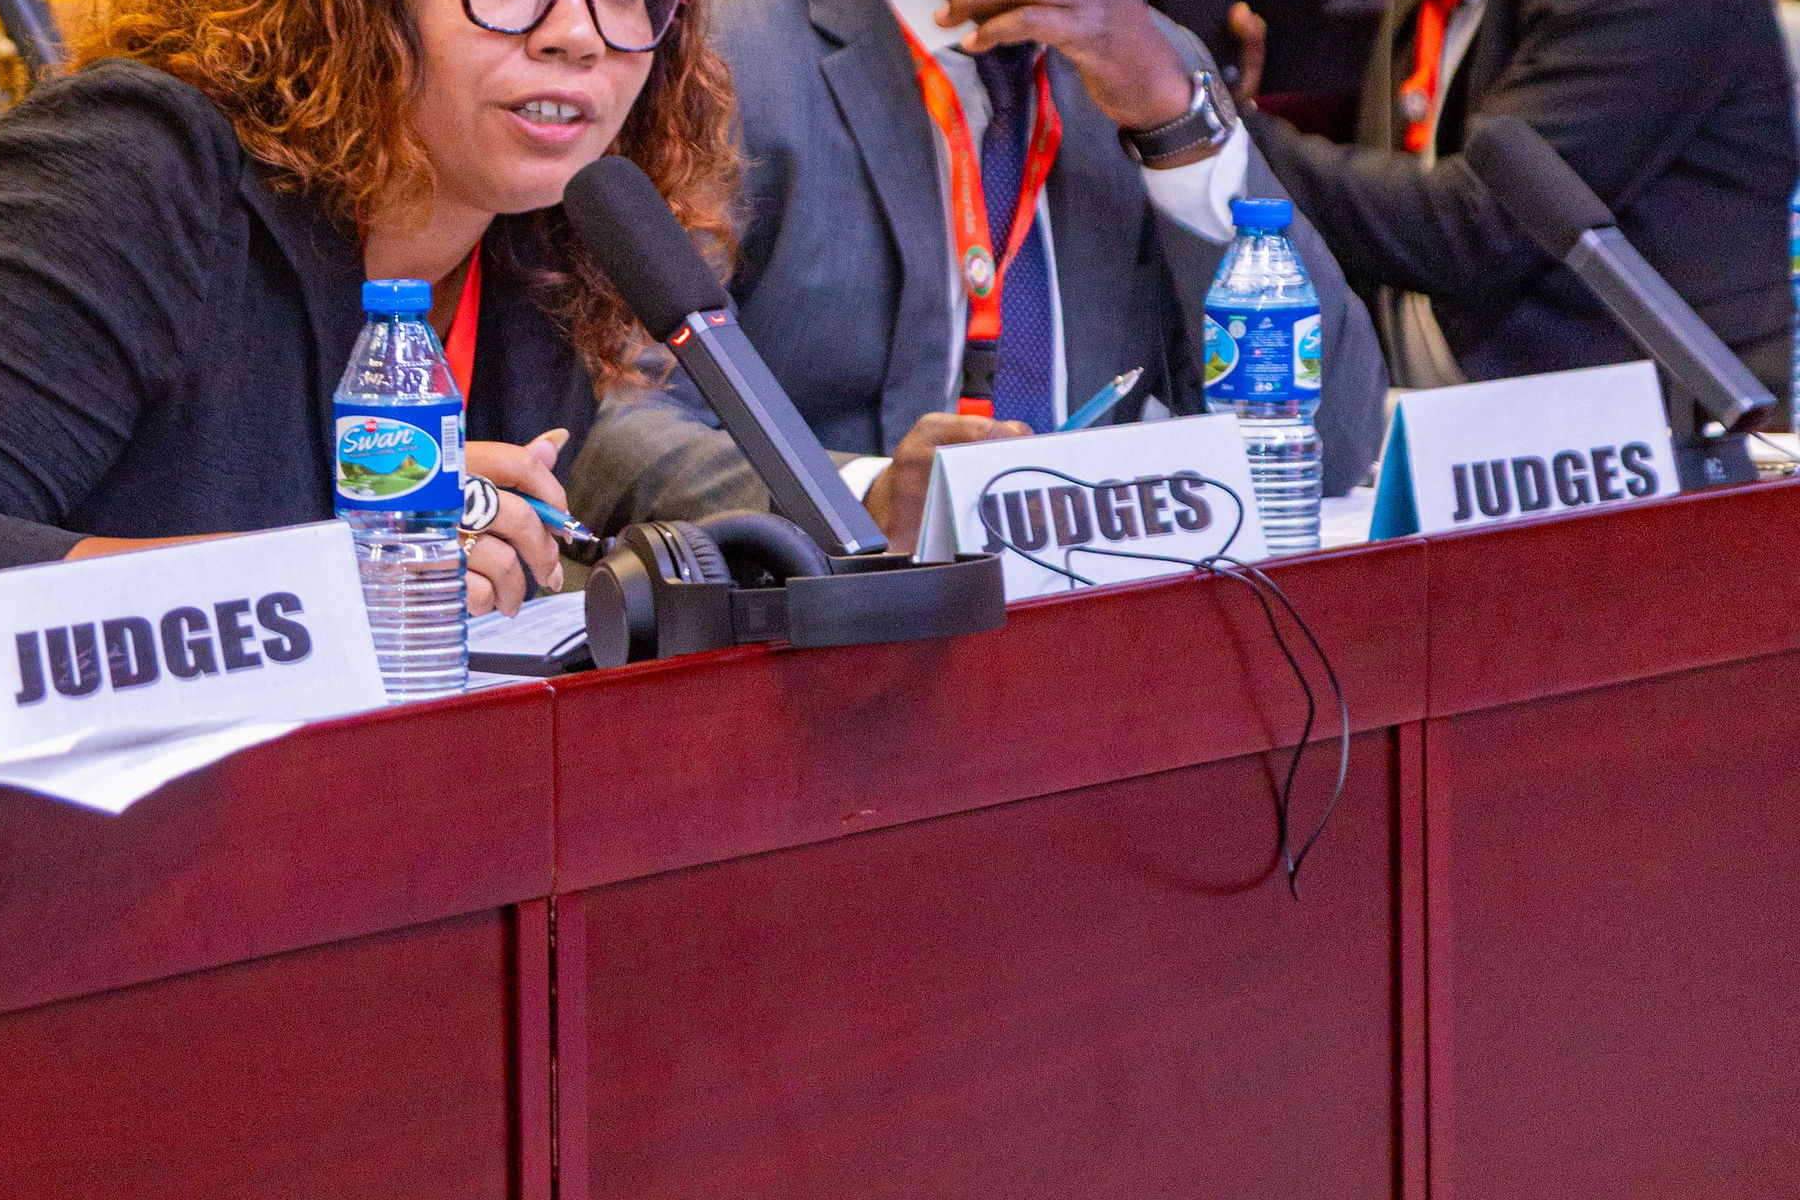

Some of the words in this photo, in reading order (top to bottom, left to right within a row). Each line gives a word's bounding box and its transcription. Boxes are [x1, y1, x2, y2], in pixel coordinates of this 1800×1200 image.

[342, 426, 415, 454] Swan
[1451, 440, 1661, 524] JUDGES
[979, 469, 1213, 554] JUDGES
[14, 591, 314, 708] JUDGES
